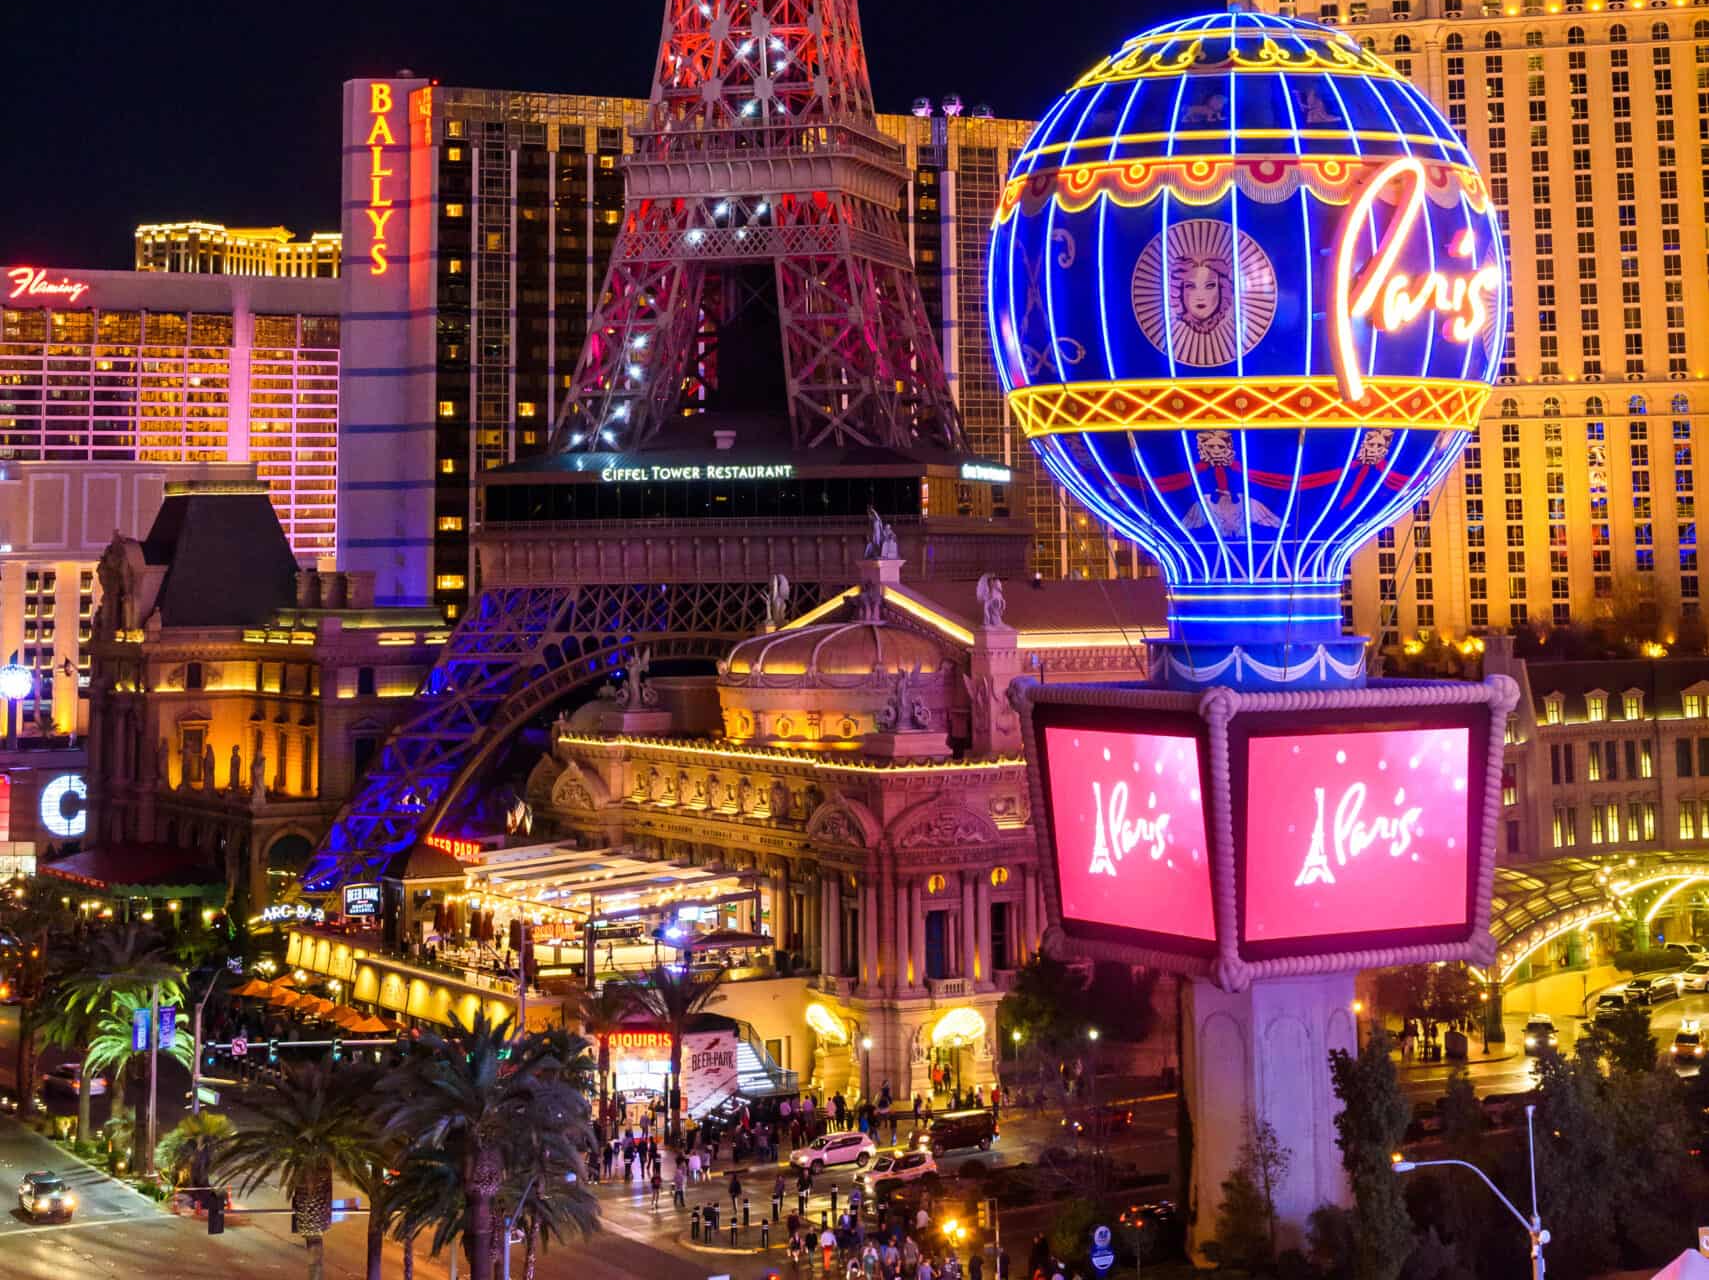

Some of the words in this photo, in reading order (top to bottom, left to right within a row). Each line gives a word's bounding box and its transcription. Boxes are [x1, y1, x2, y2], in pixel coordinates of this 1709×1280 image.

[365, 82, 395, 276] BALLYS
[1336, 157, 1499, 402] Paris
[454, 840, 480, 864] PARK
[1109, 781, 1171, 861] Paris
[1333, 781, 1423, 866] Paris
[596, 1033, 673, 1048] AIQUIRIS
